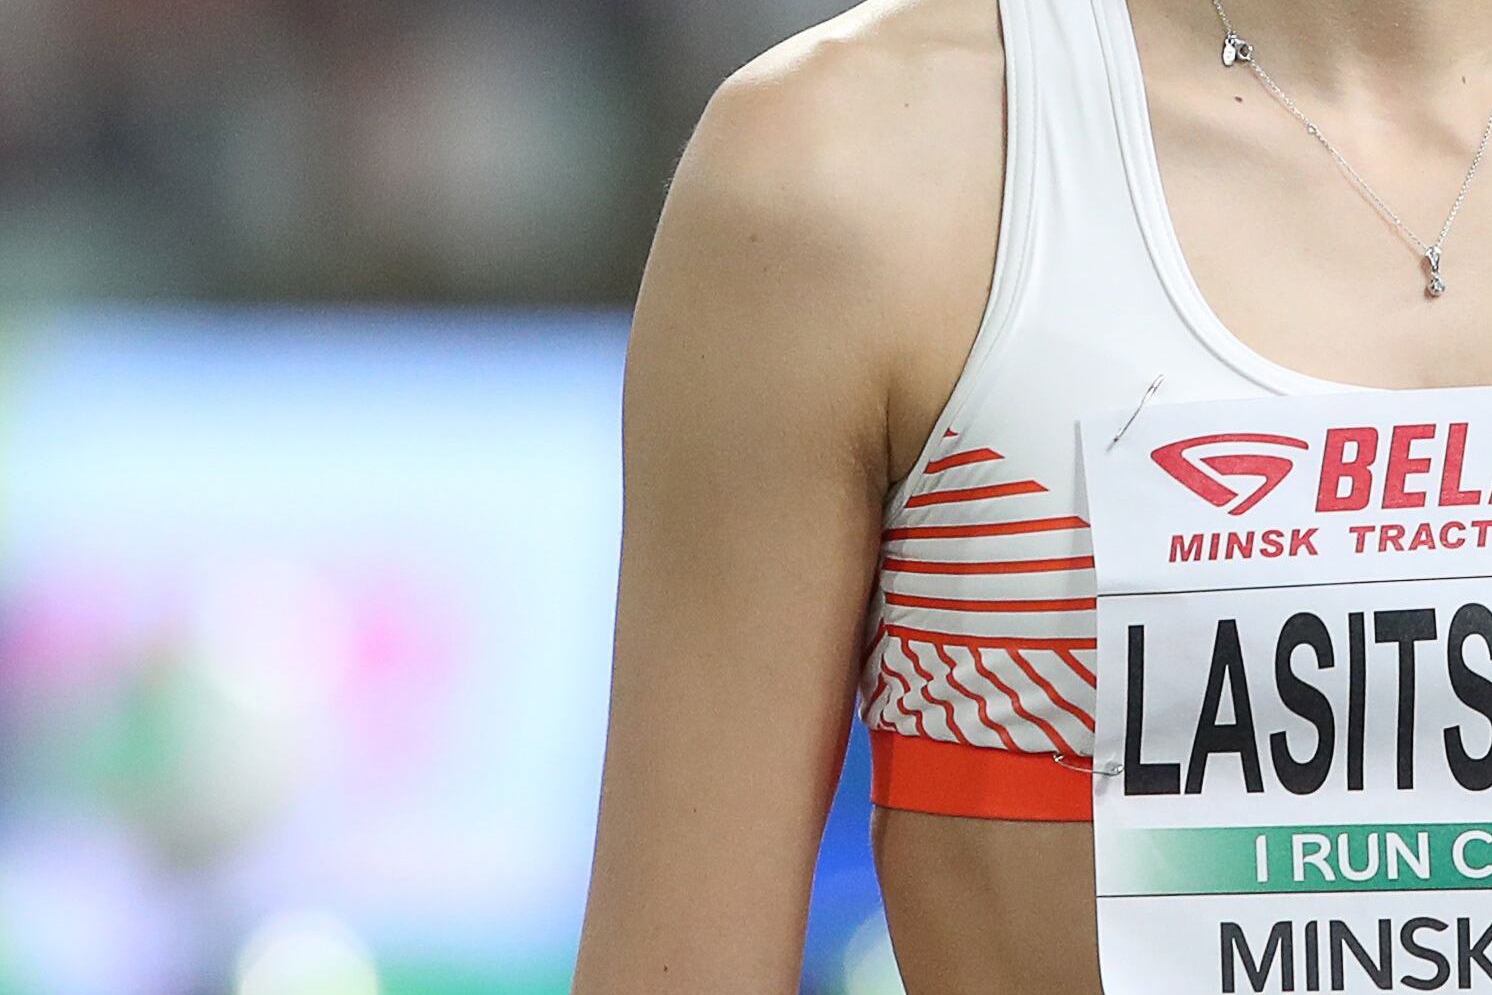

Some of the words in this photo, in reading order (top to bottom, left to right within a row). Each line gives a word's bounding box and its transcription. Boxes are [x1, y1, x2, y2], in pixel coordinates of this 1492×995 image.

[1168, 527, 1320, 563] MINSK
[1255, 834, 1269, 882] I
[1292, 831, 1430, 882] RUN
